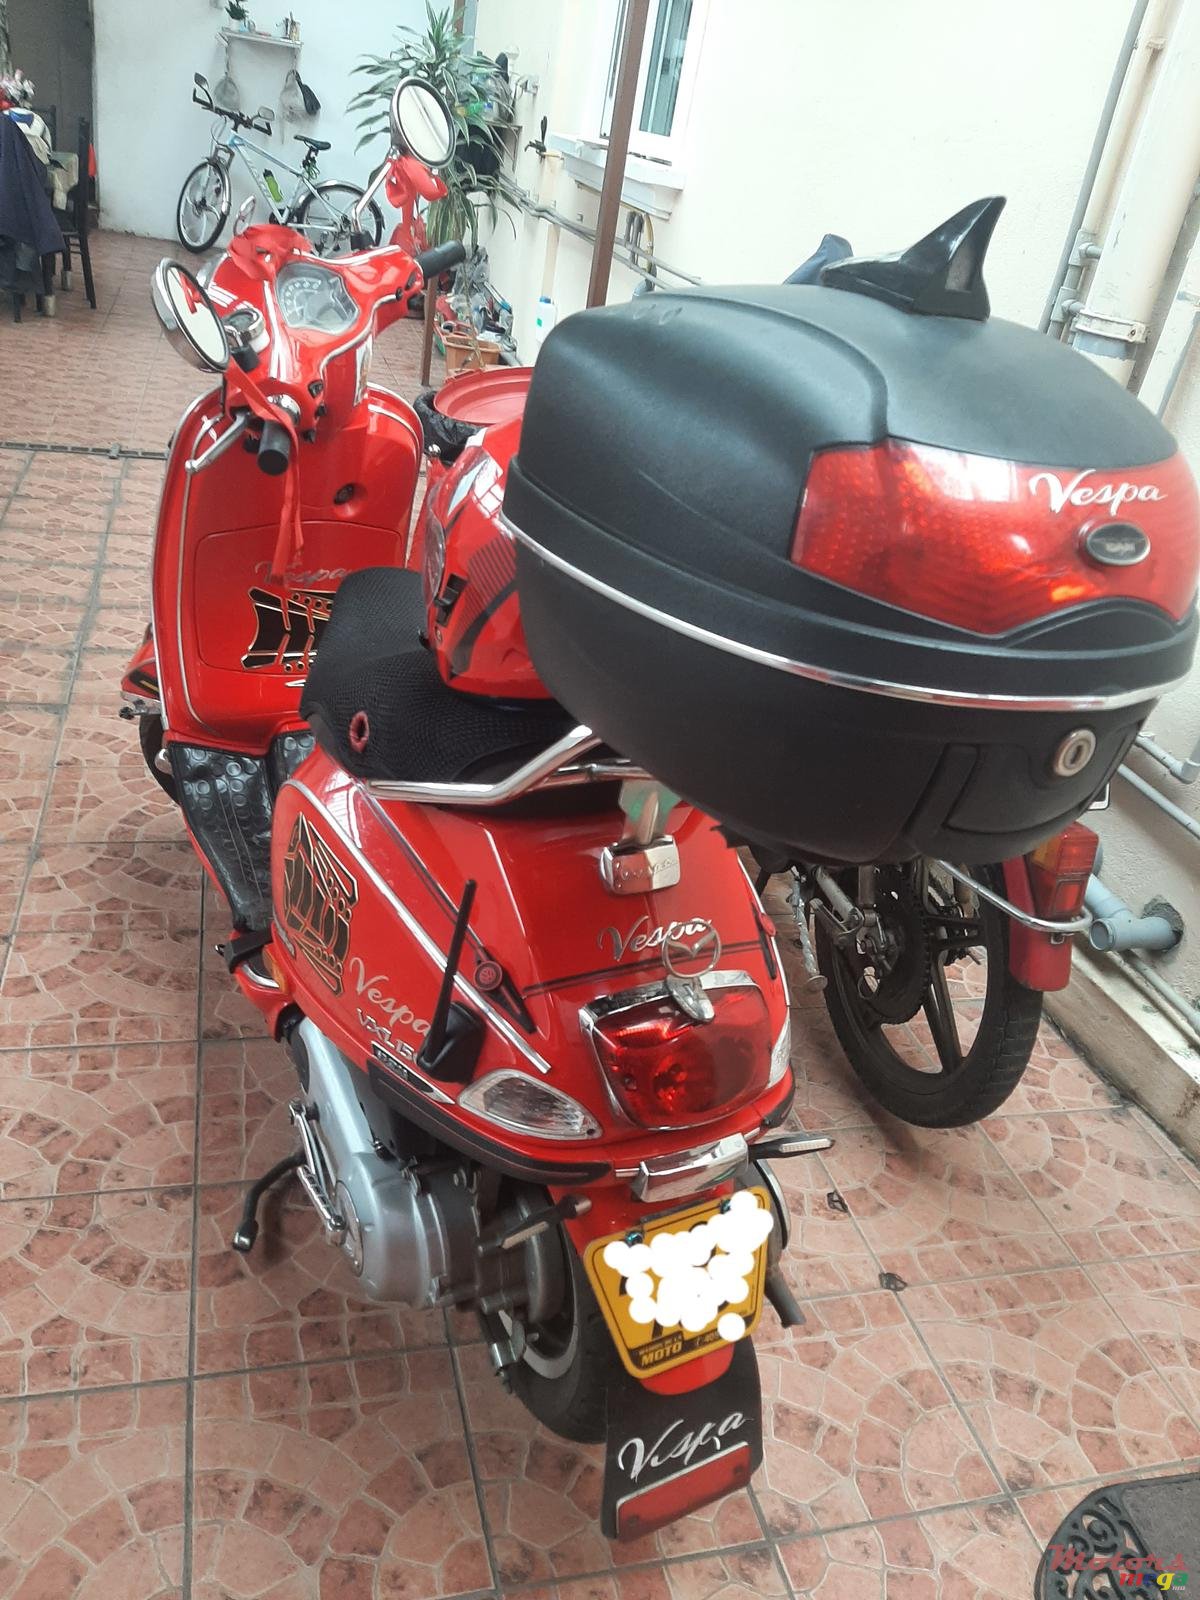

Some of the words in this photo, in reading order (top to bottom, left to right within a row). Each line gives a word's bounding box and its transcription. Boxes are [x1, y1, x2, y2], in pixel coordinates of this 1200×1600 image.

[1028, 468, 1168, 516] Vespa
[597, 915, 712, 961] Vespa
[356, 1007, 418, 1064] VXL15
[640, 1340, 683, 1367] MOTO
[617, 1412, 754, 1483] Vespa
